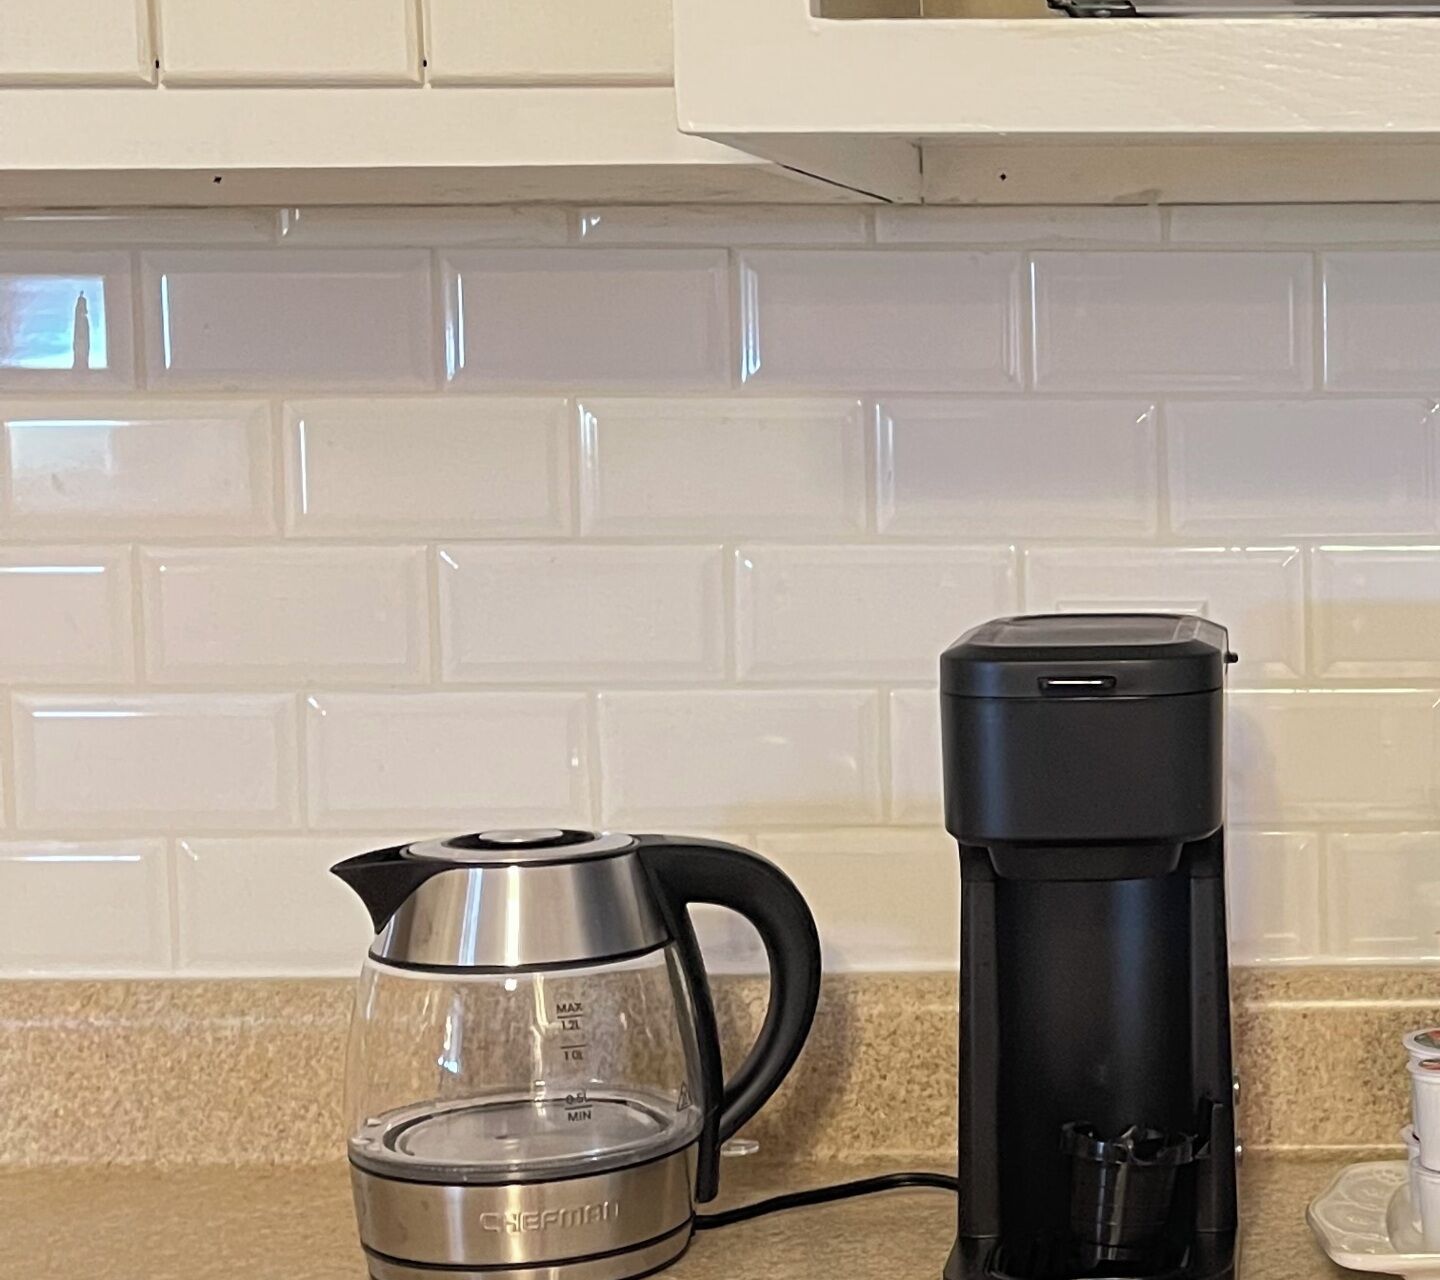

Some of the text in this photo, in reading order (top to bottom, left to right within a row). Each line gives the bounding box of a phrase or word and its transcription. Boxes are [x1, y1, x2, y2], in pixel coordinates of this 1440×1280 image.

[556, 1002, 583, 1014] MAX
[568, 1110, 592, 1122] MIN
[479, 1201, 620, 1233] CHEFMAN
